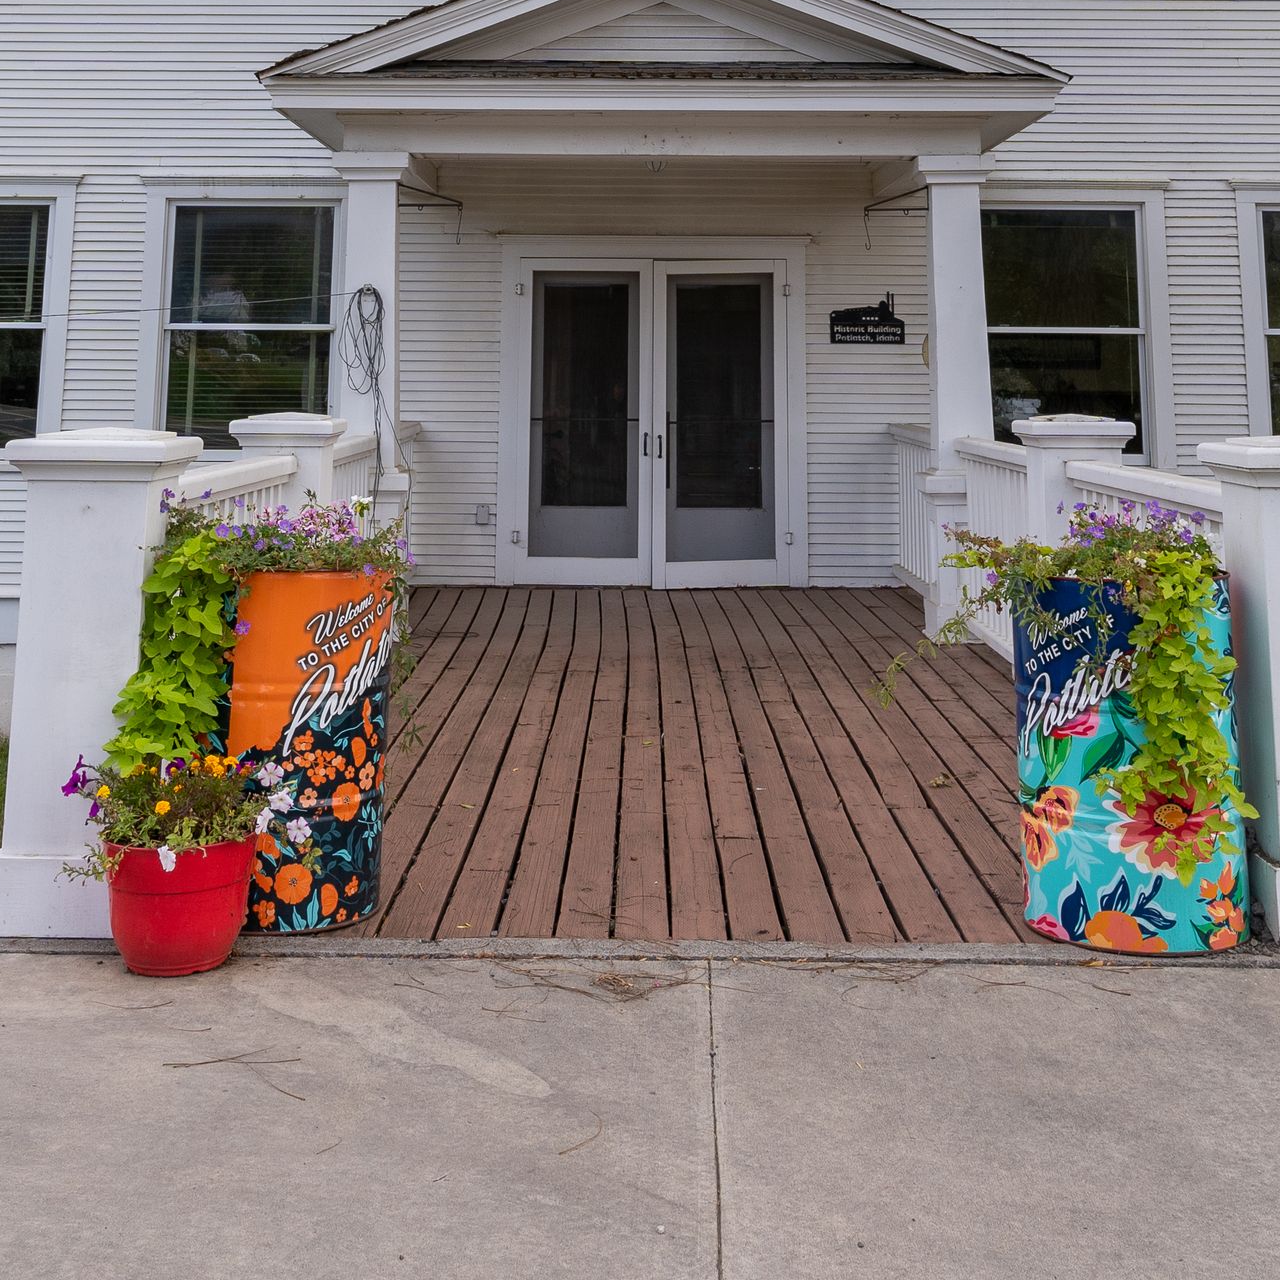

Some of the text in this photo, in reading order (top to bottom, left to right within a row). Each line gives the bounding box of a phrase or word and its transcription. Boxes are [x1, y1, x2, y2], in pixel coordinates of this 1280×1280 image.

[833, 325, 902, 334] Historic Building
[297, 597, 388, 671] TO THE CITY OF
[306, 593, 375, 645] Welcome
[1024, 658, 1038, 675] TO
[1037, 643, 1062, 665] THE
